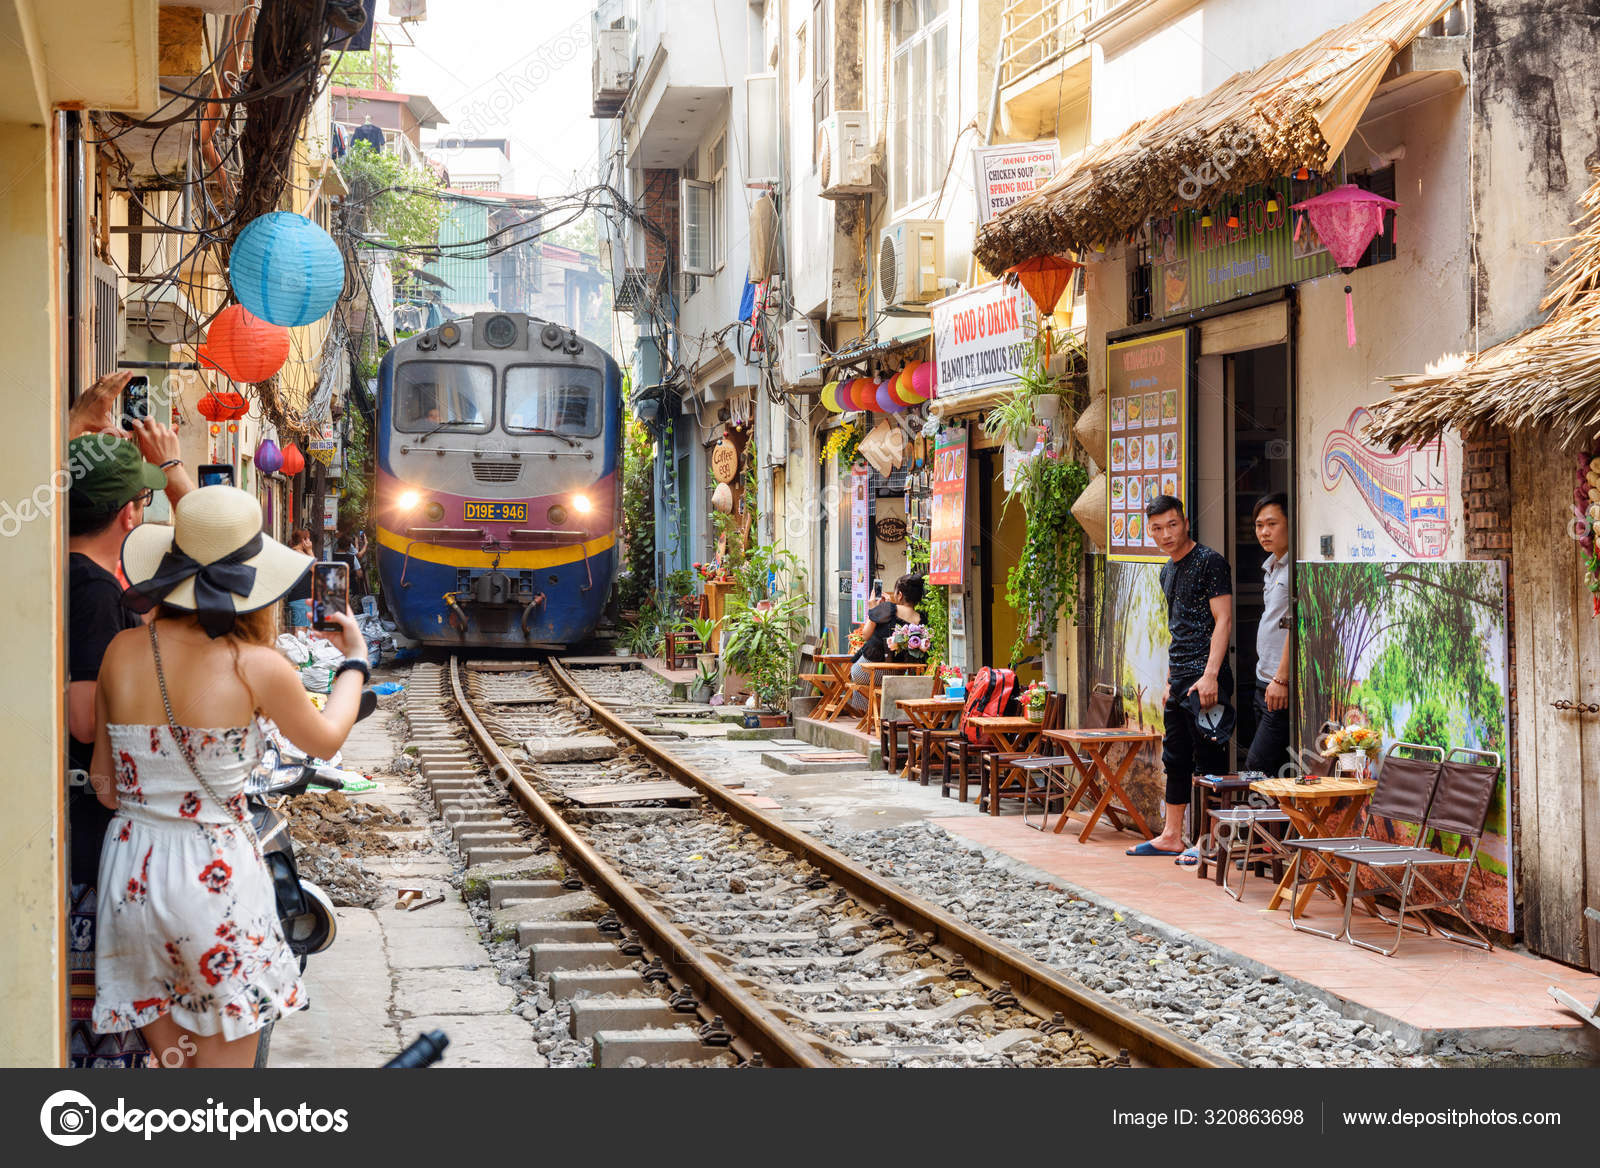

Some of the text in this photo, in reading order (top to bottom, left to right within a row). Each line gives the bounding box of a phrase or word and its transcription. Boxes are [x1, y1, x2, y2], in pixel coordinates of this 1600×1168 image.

[1002, 156, 1026, 165] MENU
[1028, 154, 1052, 163] FOOD
[988, 166, 1034, 181] CHICKEN SOUP
[989, 180, 1035, 195] SPRING ROLL
[991, 196, 1016, 208] STEAM
[953, 309, 977, 346] FOOD
[978, 306, 986, 339] &
[986, 295, 1020, 337] DRINK
[941, 356, 964, 385] HANOI
[965, 352, 976, 379] DE
[975, 345, 1008, 377] LICIOUS
[713, 450, 734, 464] Coffee
[719, 463, 731, 479] egg
